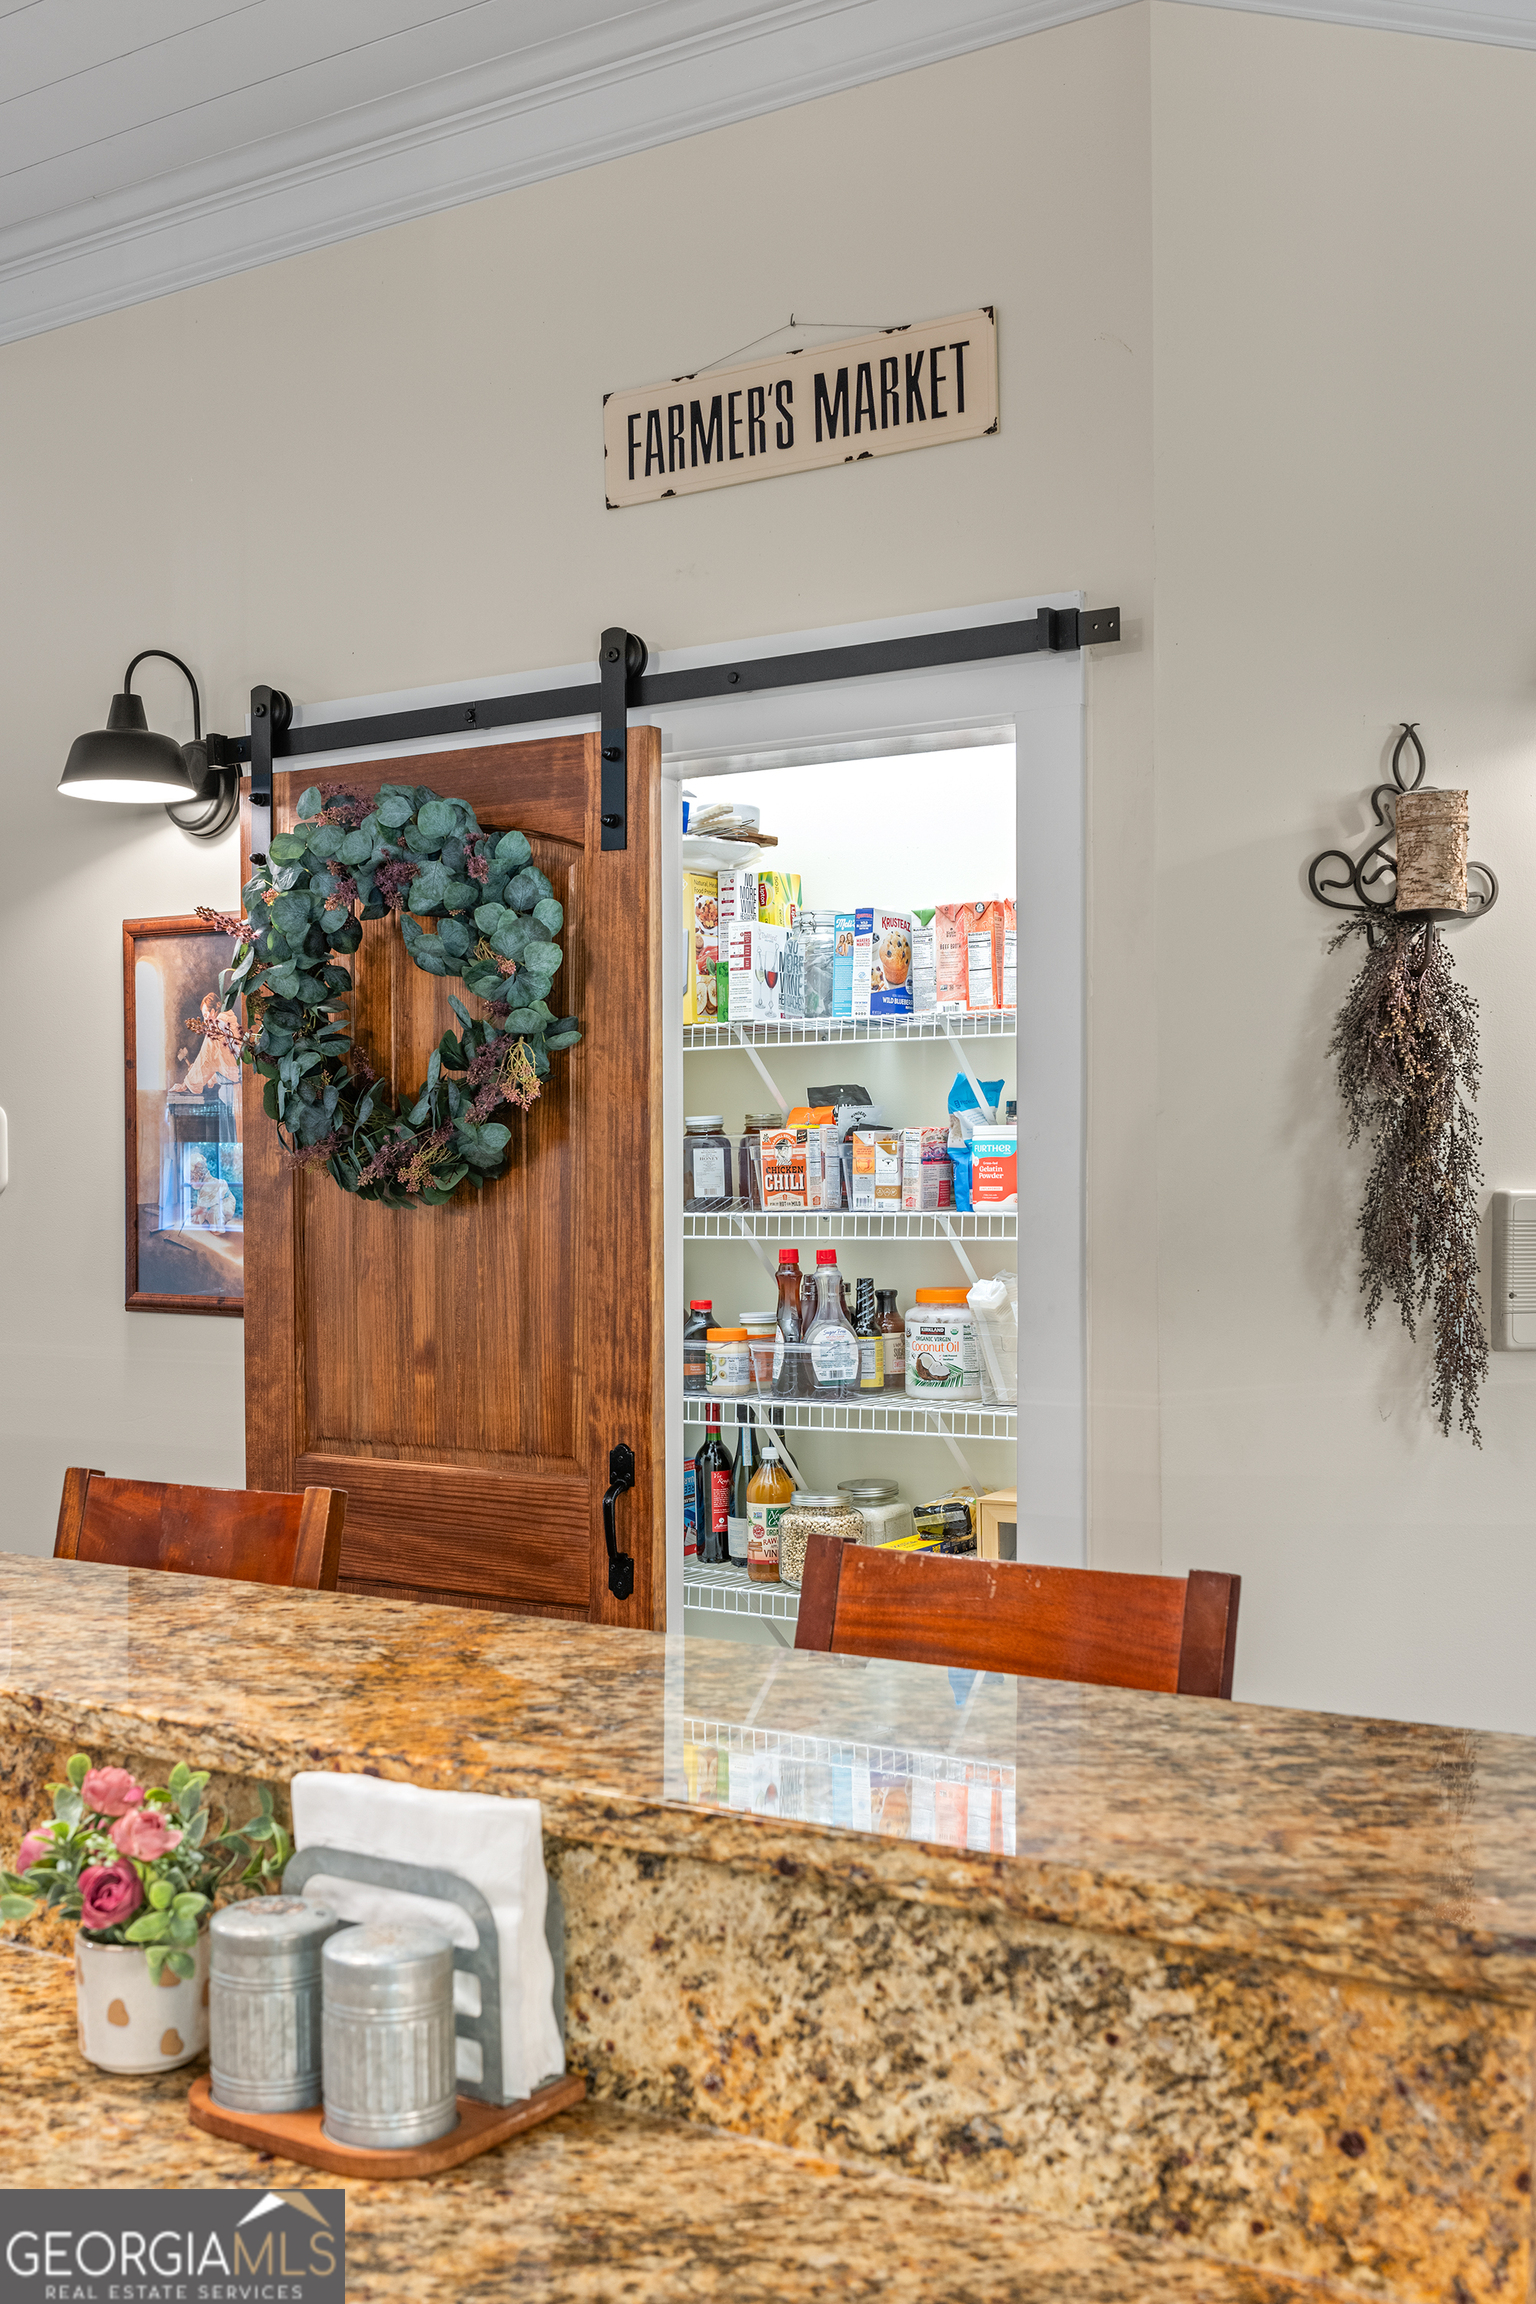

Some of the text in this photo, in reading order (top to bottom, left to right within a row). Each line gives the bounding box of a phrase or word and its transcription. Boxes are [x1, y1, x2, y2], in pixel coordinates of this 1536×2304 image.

[627, 340, 970, 480] FARMER'S MARKET
[881, 916, 911, 933] KRUSTEAZ
[766, 1166, 804, 1174] CHICKEN
[764, 1173, 806, 1192] CHILI
[911, 1340, 960, 1353] Coconut Oil
[763, 1537, 778, 1546] RAW
